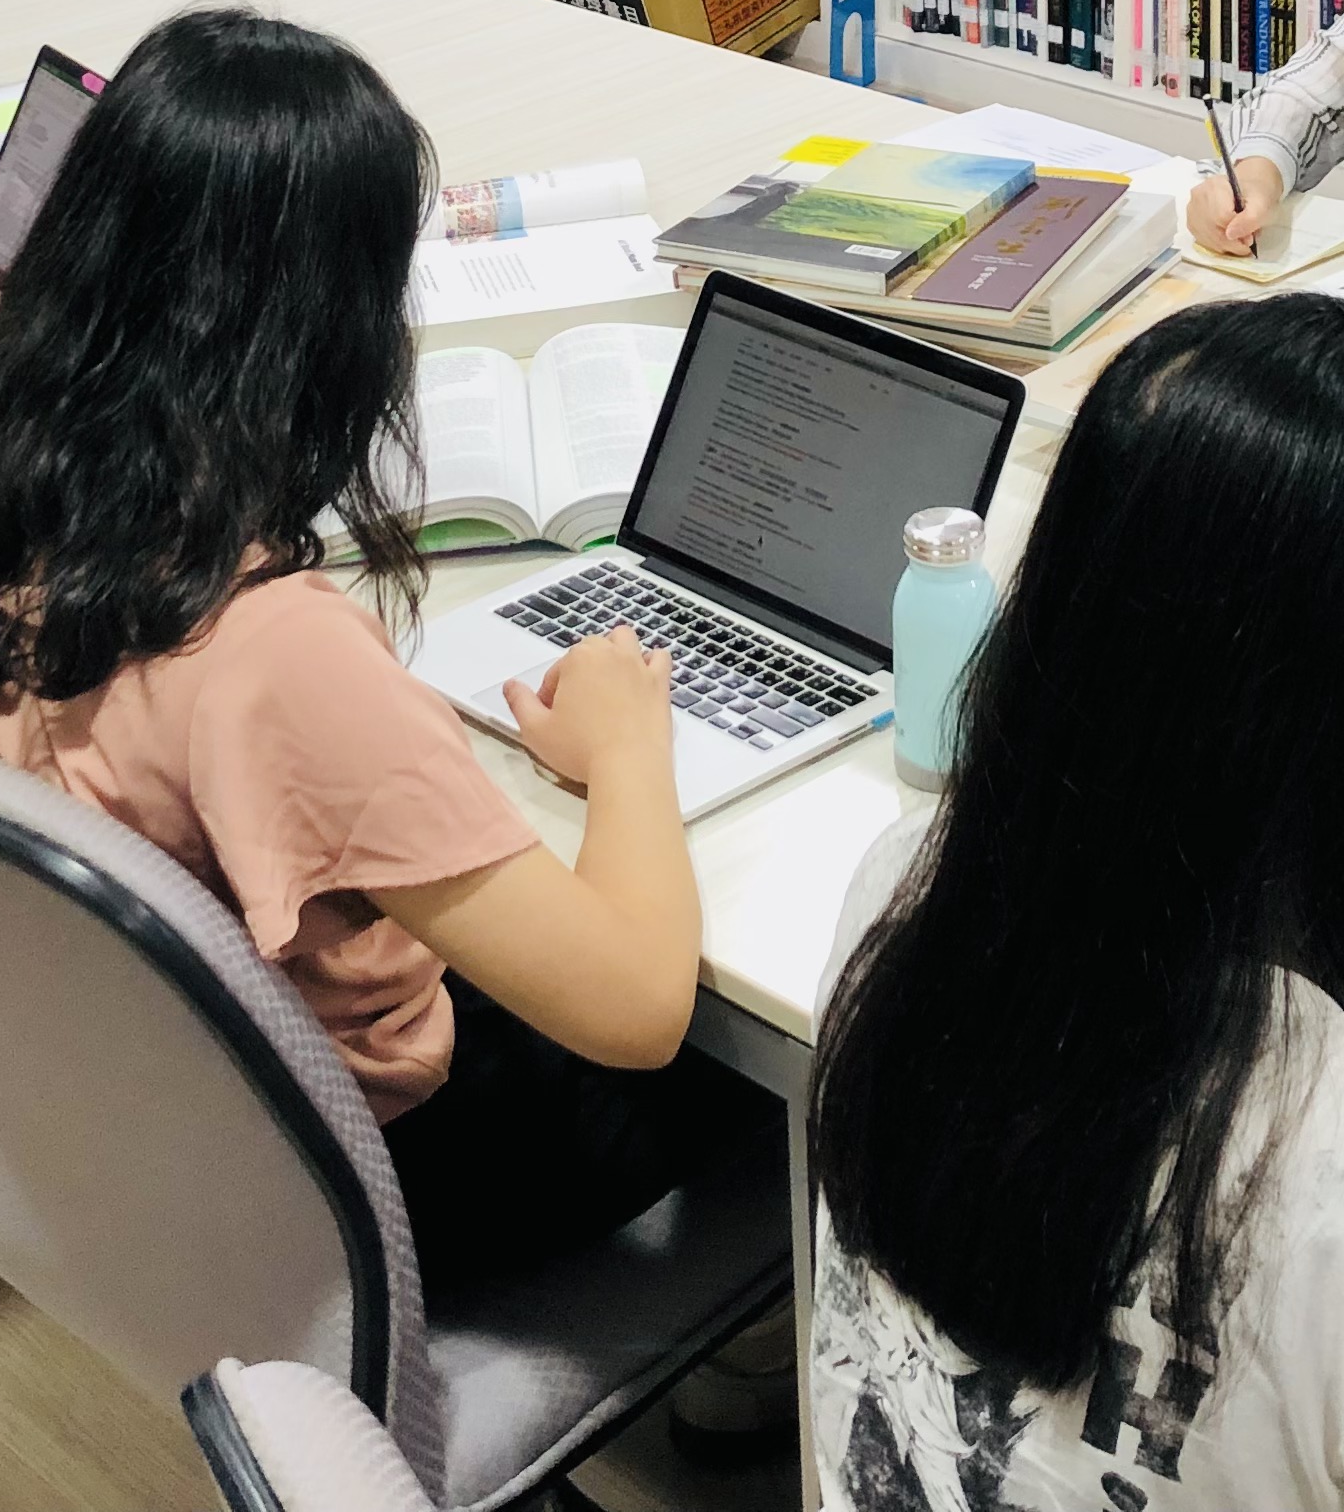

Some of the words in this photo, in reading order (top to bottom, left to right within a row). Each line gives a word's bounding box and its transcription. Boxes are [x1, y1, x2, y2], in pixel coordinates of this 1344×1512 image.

[1191, 10, 1201, 25] OF
[1259, 12, 1269, 39] AND
[1191, 27, 1201, 46] THE
